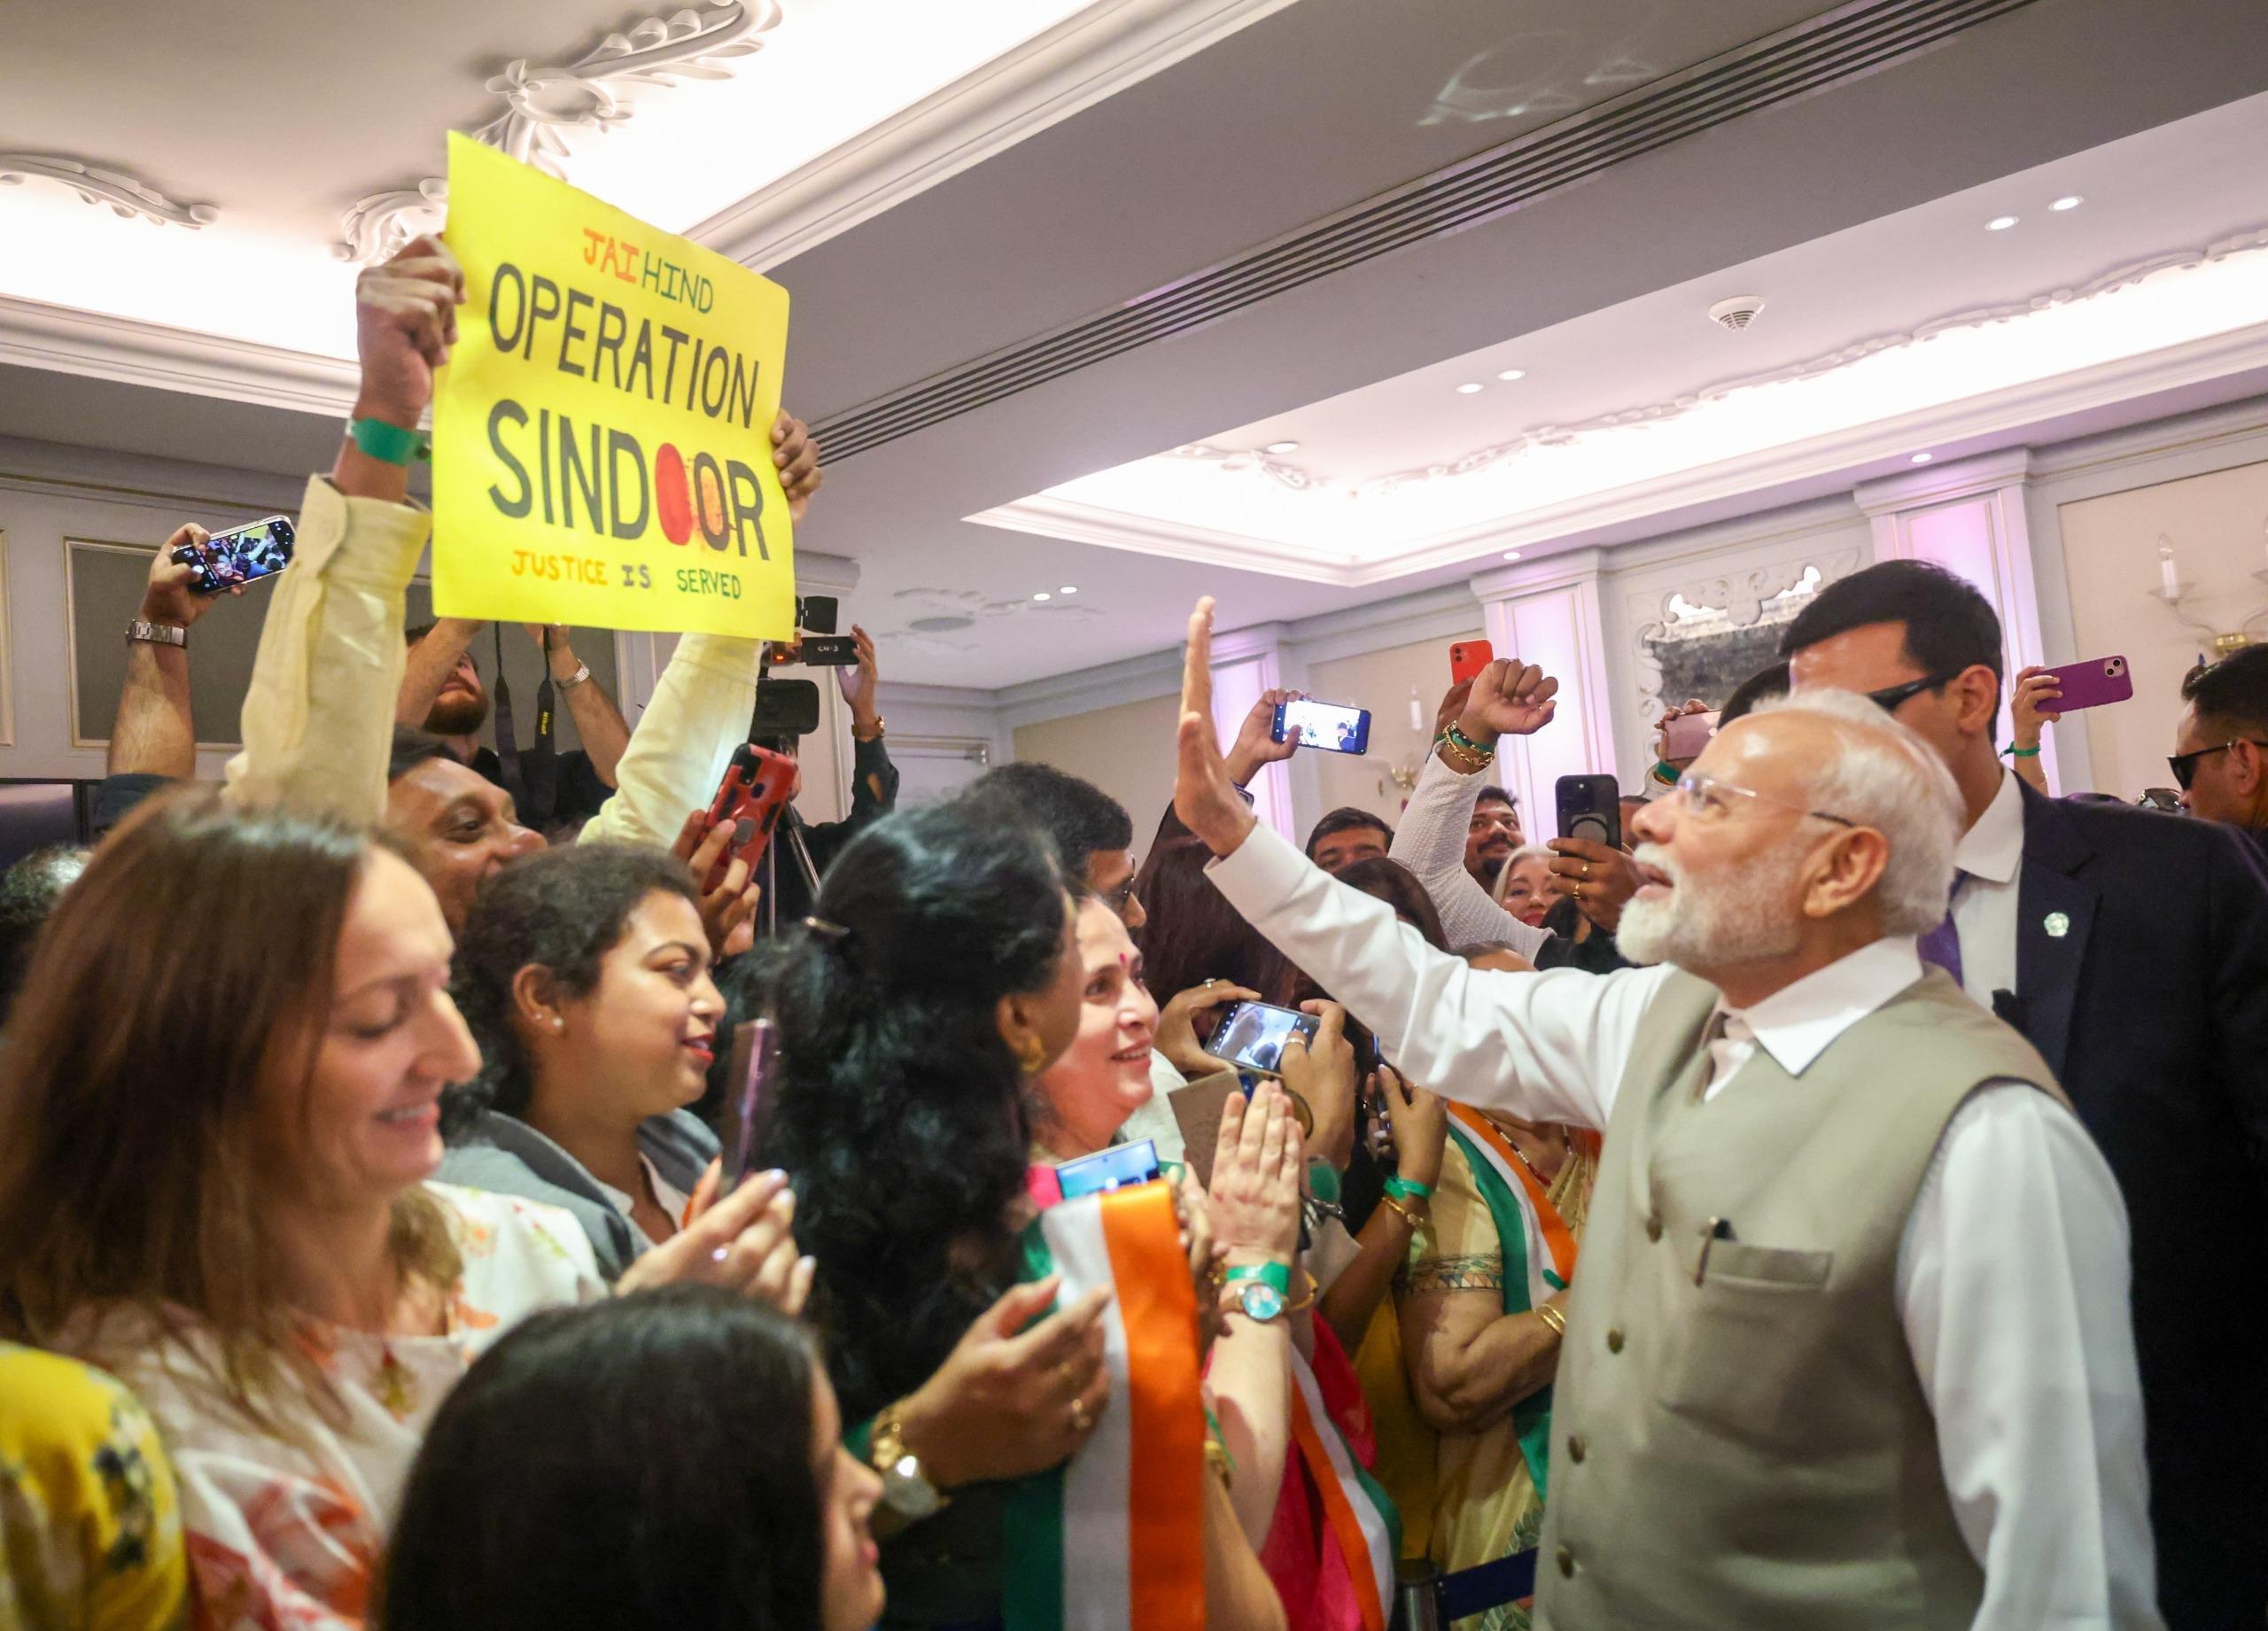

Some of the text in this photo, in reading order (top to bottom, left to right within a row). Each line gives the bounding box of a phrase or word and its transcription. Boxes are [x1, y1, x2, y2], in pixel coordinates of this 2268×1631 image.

[582, 227, 713, 315] JAI HIND
[489, 262, 760, 430] OPERATION
[487, 399, 771, 562] SINDOOR
[511, 549, 742, 600] JUSTICE IS SERVED
